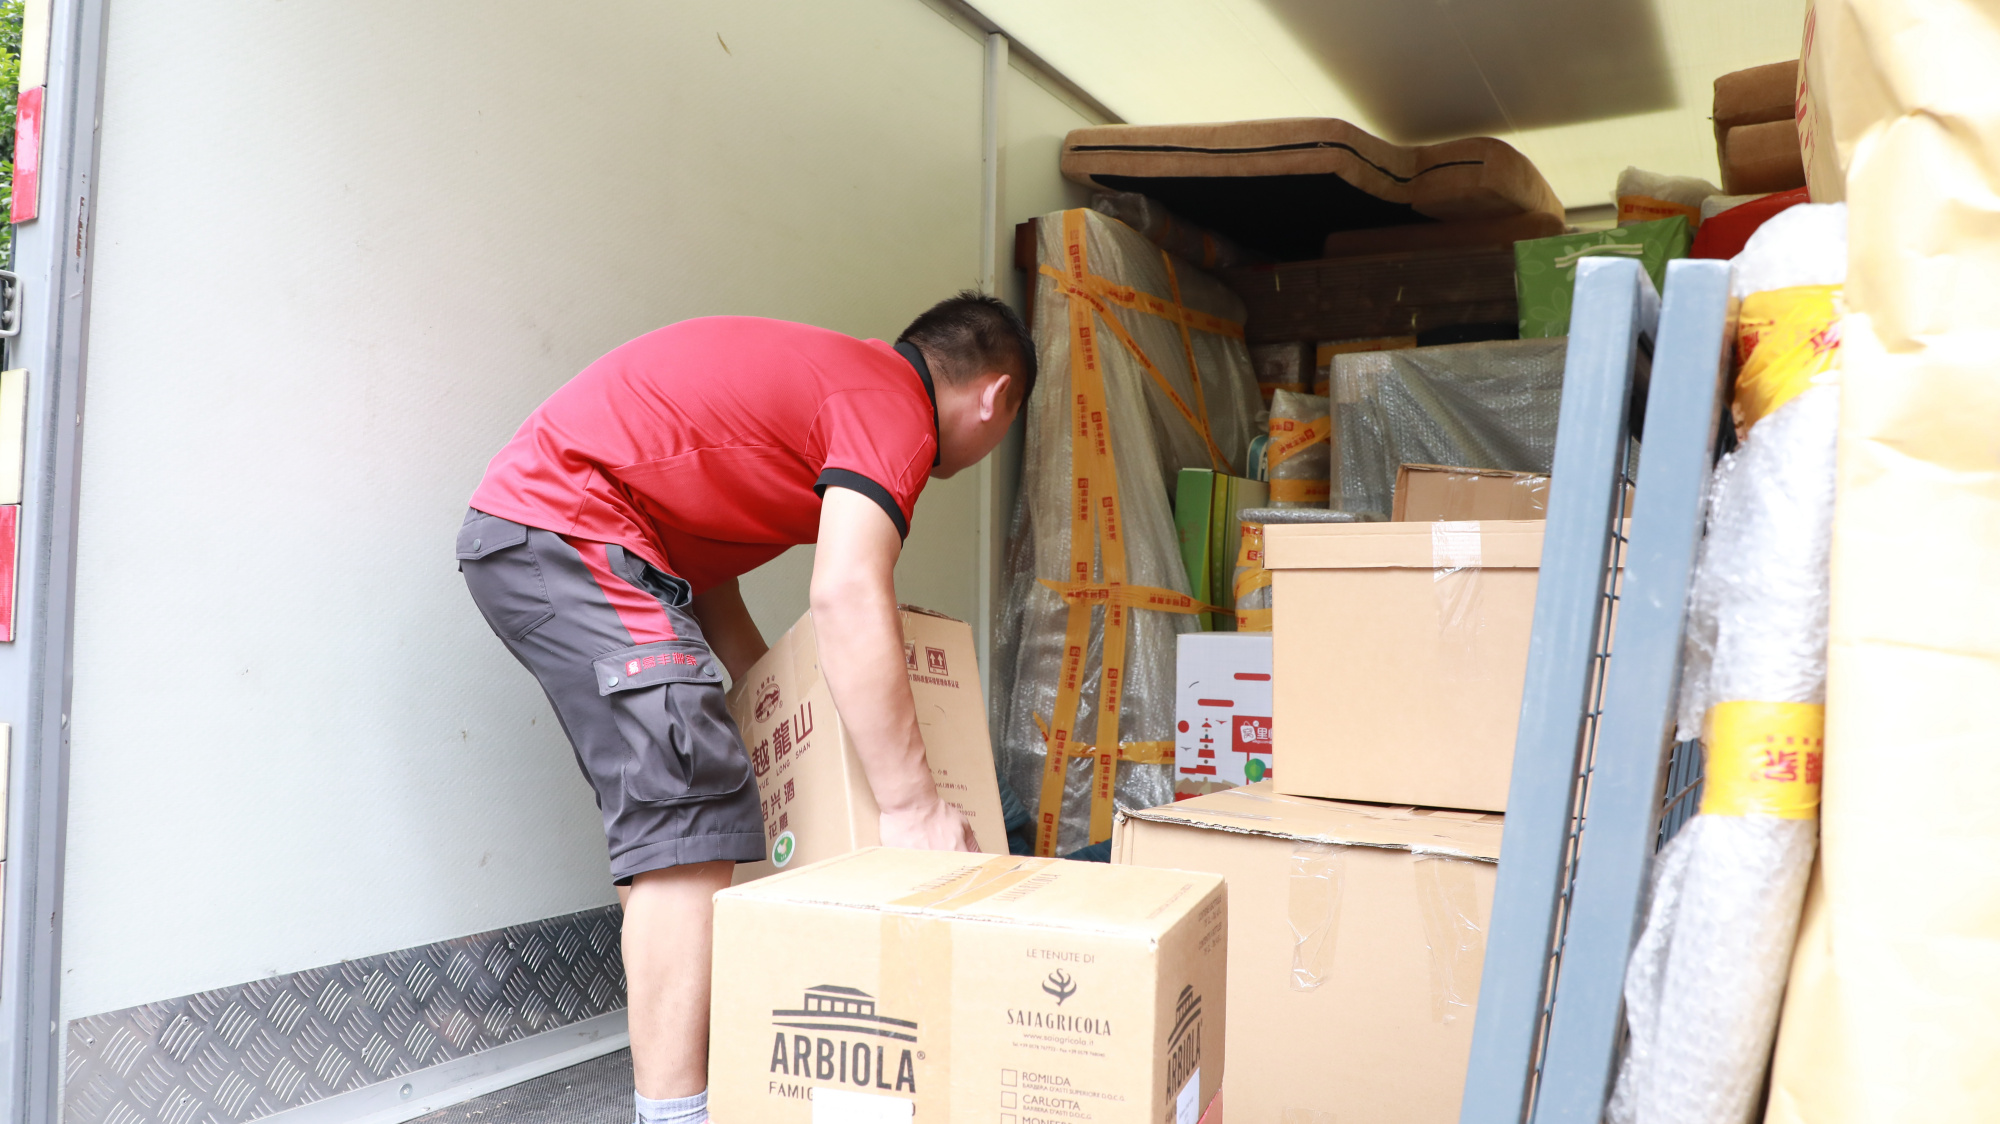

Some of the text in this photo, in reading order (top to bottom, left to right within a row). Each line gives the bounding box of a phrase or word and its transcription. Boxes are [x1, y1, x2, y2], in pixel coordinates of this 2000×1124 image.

[776, 759, 790, 776] LONG
[796, 741, 811, 760] SHAN
[1026, 948, 1094, 964] LE TENUTE DI
[1007, 1008, 1111, 1036] SAIAGRICOLA
[1024, 1033, 1094, 1046] www.saiagricola.it
[770, 1032, 916, 1094] ARBIOLA
[1166, 1022, 1200, 1106] ARBIOLA
[1022, 1072, 1071, 1086] ROMILDA
[1022, 1083, 1048, 1091] BARBERA
[1069, 1089, 1100, 1098] SUPERIORE
[1023, 1094, 1080, 1111] CARLOTTA
